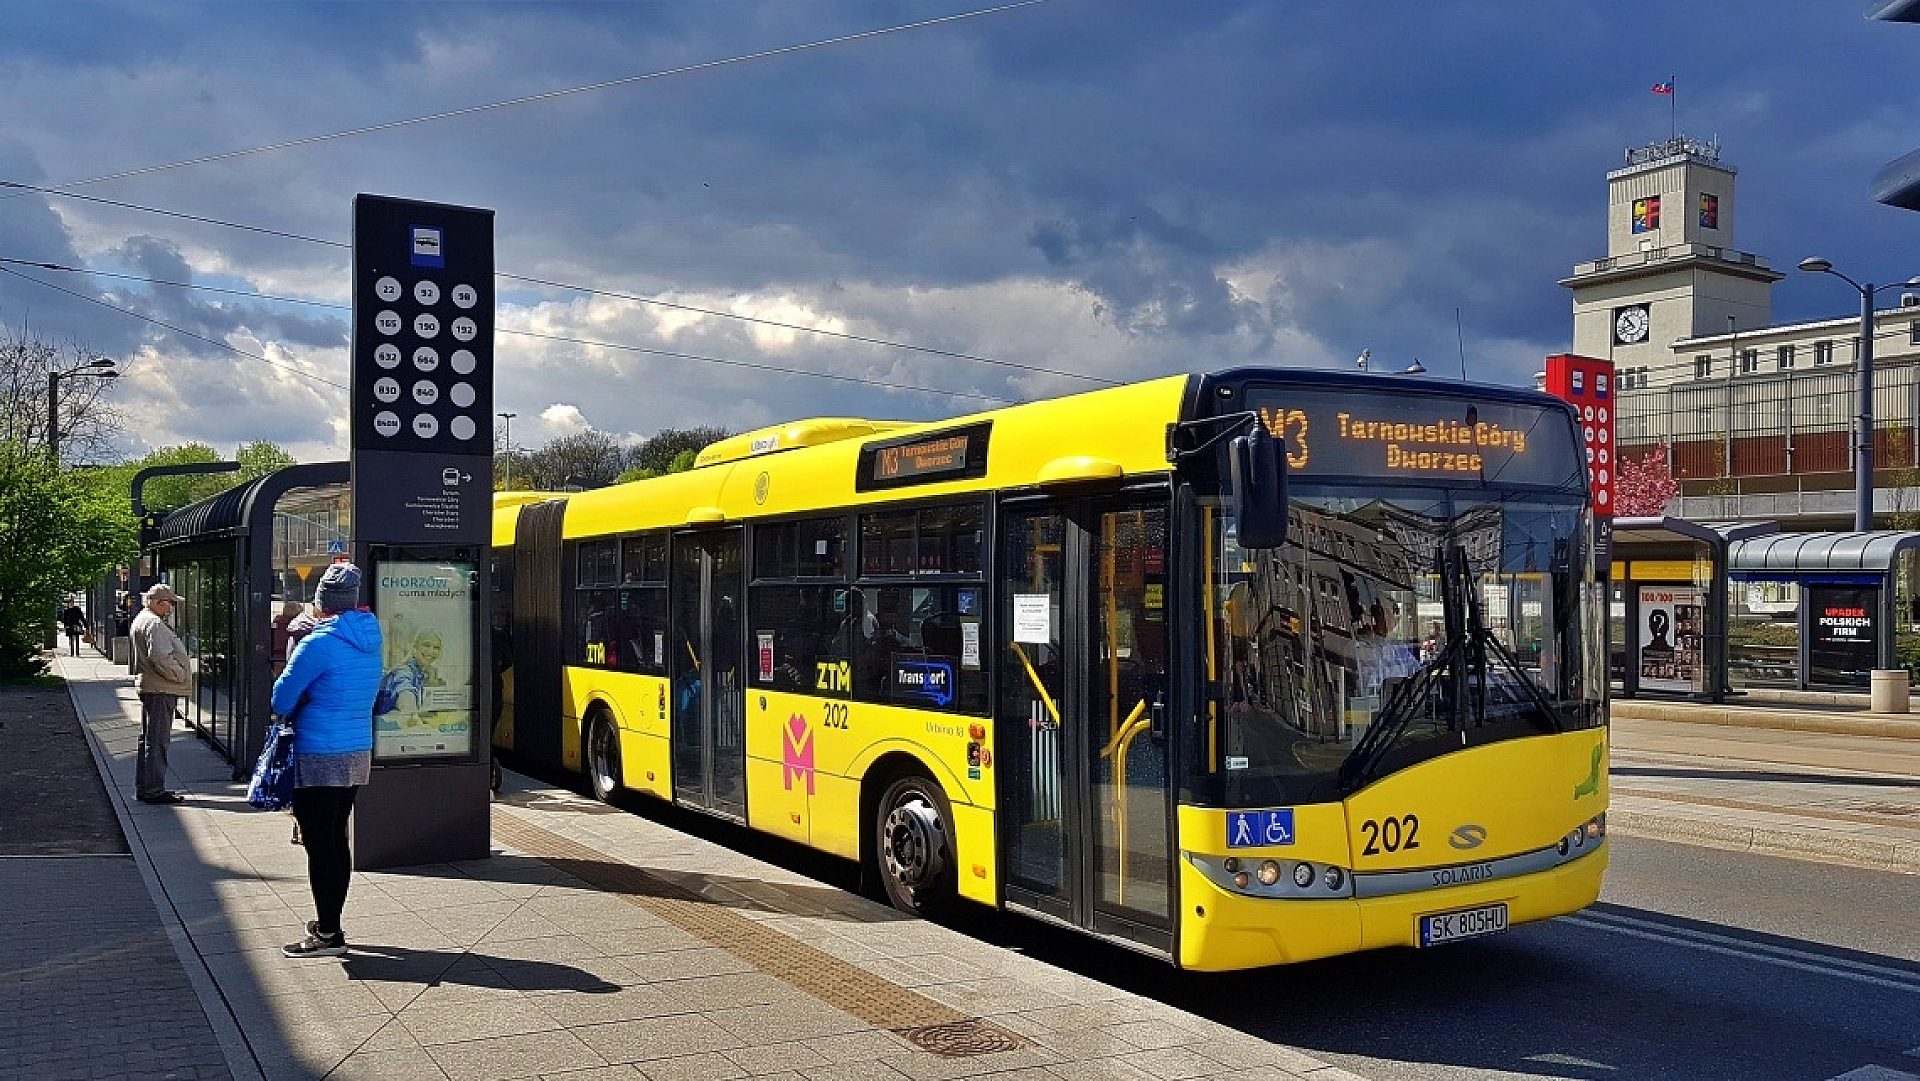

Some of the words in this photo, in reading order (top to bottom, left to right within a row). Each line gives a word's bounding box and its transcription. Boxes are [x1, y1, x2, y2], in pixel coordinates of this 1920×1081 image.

[383, 285, 395, 294] 22
[420, 289, 433, 298] 92
[380, 319, 397, 328] 165
[418, 322, 435, 331] 190
[456, 325, 473, 334] 192
[1336, 411, 1471, 444] Tarnowskie
[1474, 421, 1526, 453] Góry
[1386, 443, 1483, 471] Dworzec
[1825, 607, 1865, 617] UPADEK
[1819, 617, 1870, 627] POLSKICH
[1833, 627, 1857, 636] FIRM
[587, 642, 606, 664] ZTM
[816, 660, 851, 692] ZTM
[823, 702, 848, 730] 202
[1360, 814, 1420, 856] 202
[1432, 864, 1493, 886] SOLARIS
[1433, 915, 1454, 939] SK
[1459, 906, 1503, 934] 805HU
